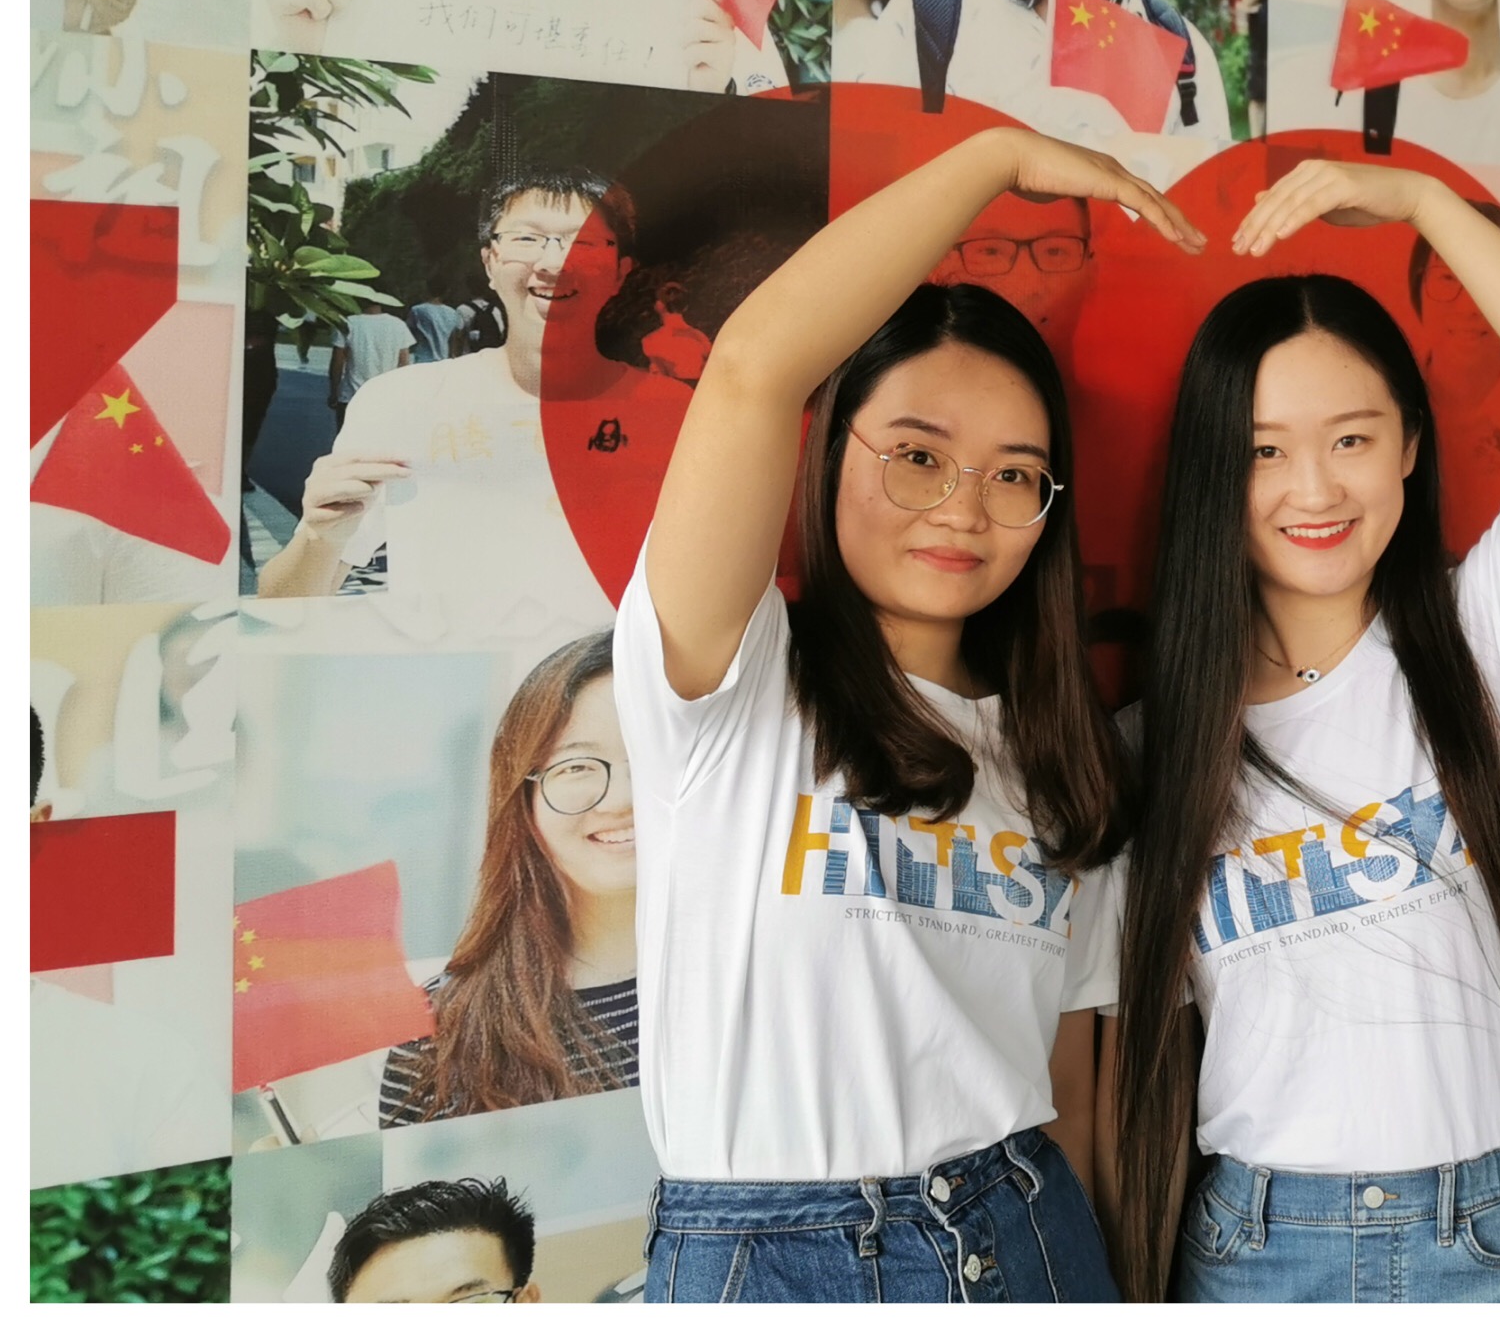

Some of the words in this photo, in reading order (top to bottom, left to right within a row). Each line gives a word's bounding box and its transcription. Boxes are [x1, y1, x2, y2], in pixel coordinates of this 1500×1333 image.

[1360, 898, 1423, 928] GREATEST
[1429, 880, 1469, 906] EFFORT
[844, 907, 913, 926] STRICTEST
[918, 915, 982, 940] STANDARD,
[986, 928, 1039, 949] GREATEST
[1040, 938, 1066, 959] EFFORT
